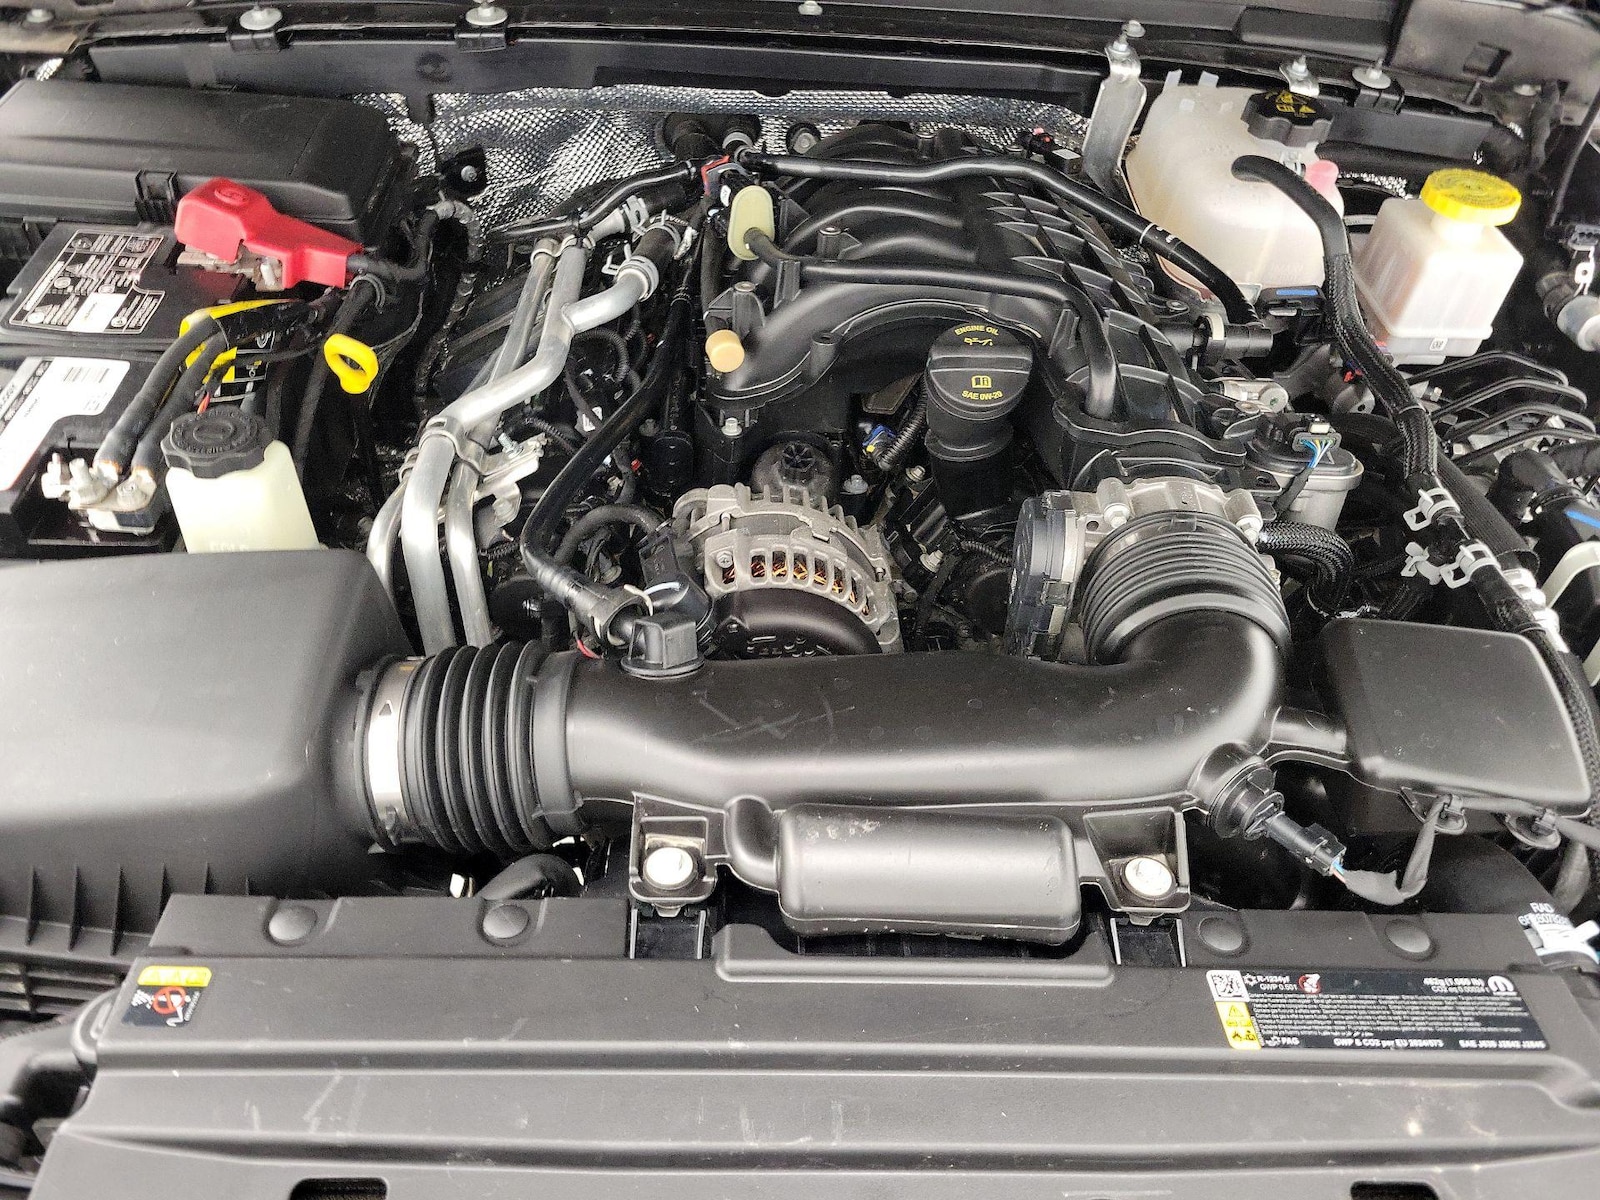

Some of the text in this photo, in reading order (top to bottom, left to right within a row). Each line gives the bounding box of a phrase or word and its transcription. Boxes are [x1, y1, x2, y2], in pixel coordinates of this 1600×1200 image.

[955, 325, 999, 336] ENGINE OIL
[962, 390, 1003, 400] SAE 0W-20
[1530, 902, 1555, 913] RAD
[1280, 1037, 1300, 1046] PAG
[1333, 1038, 1354, 1047] GWP
[1362, 1038, 1381, 1047] CO2
[1395, 1038, 1408, 1047] EU
[1459, 1040, 1477, 1049] SAE
